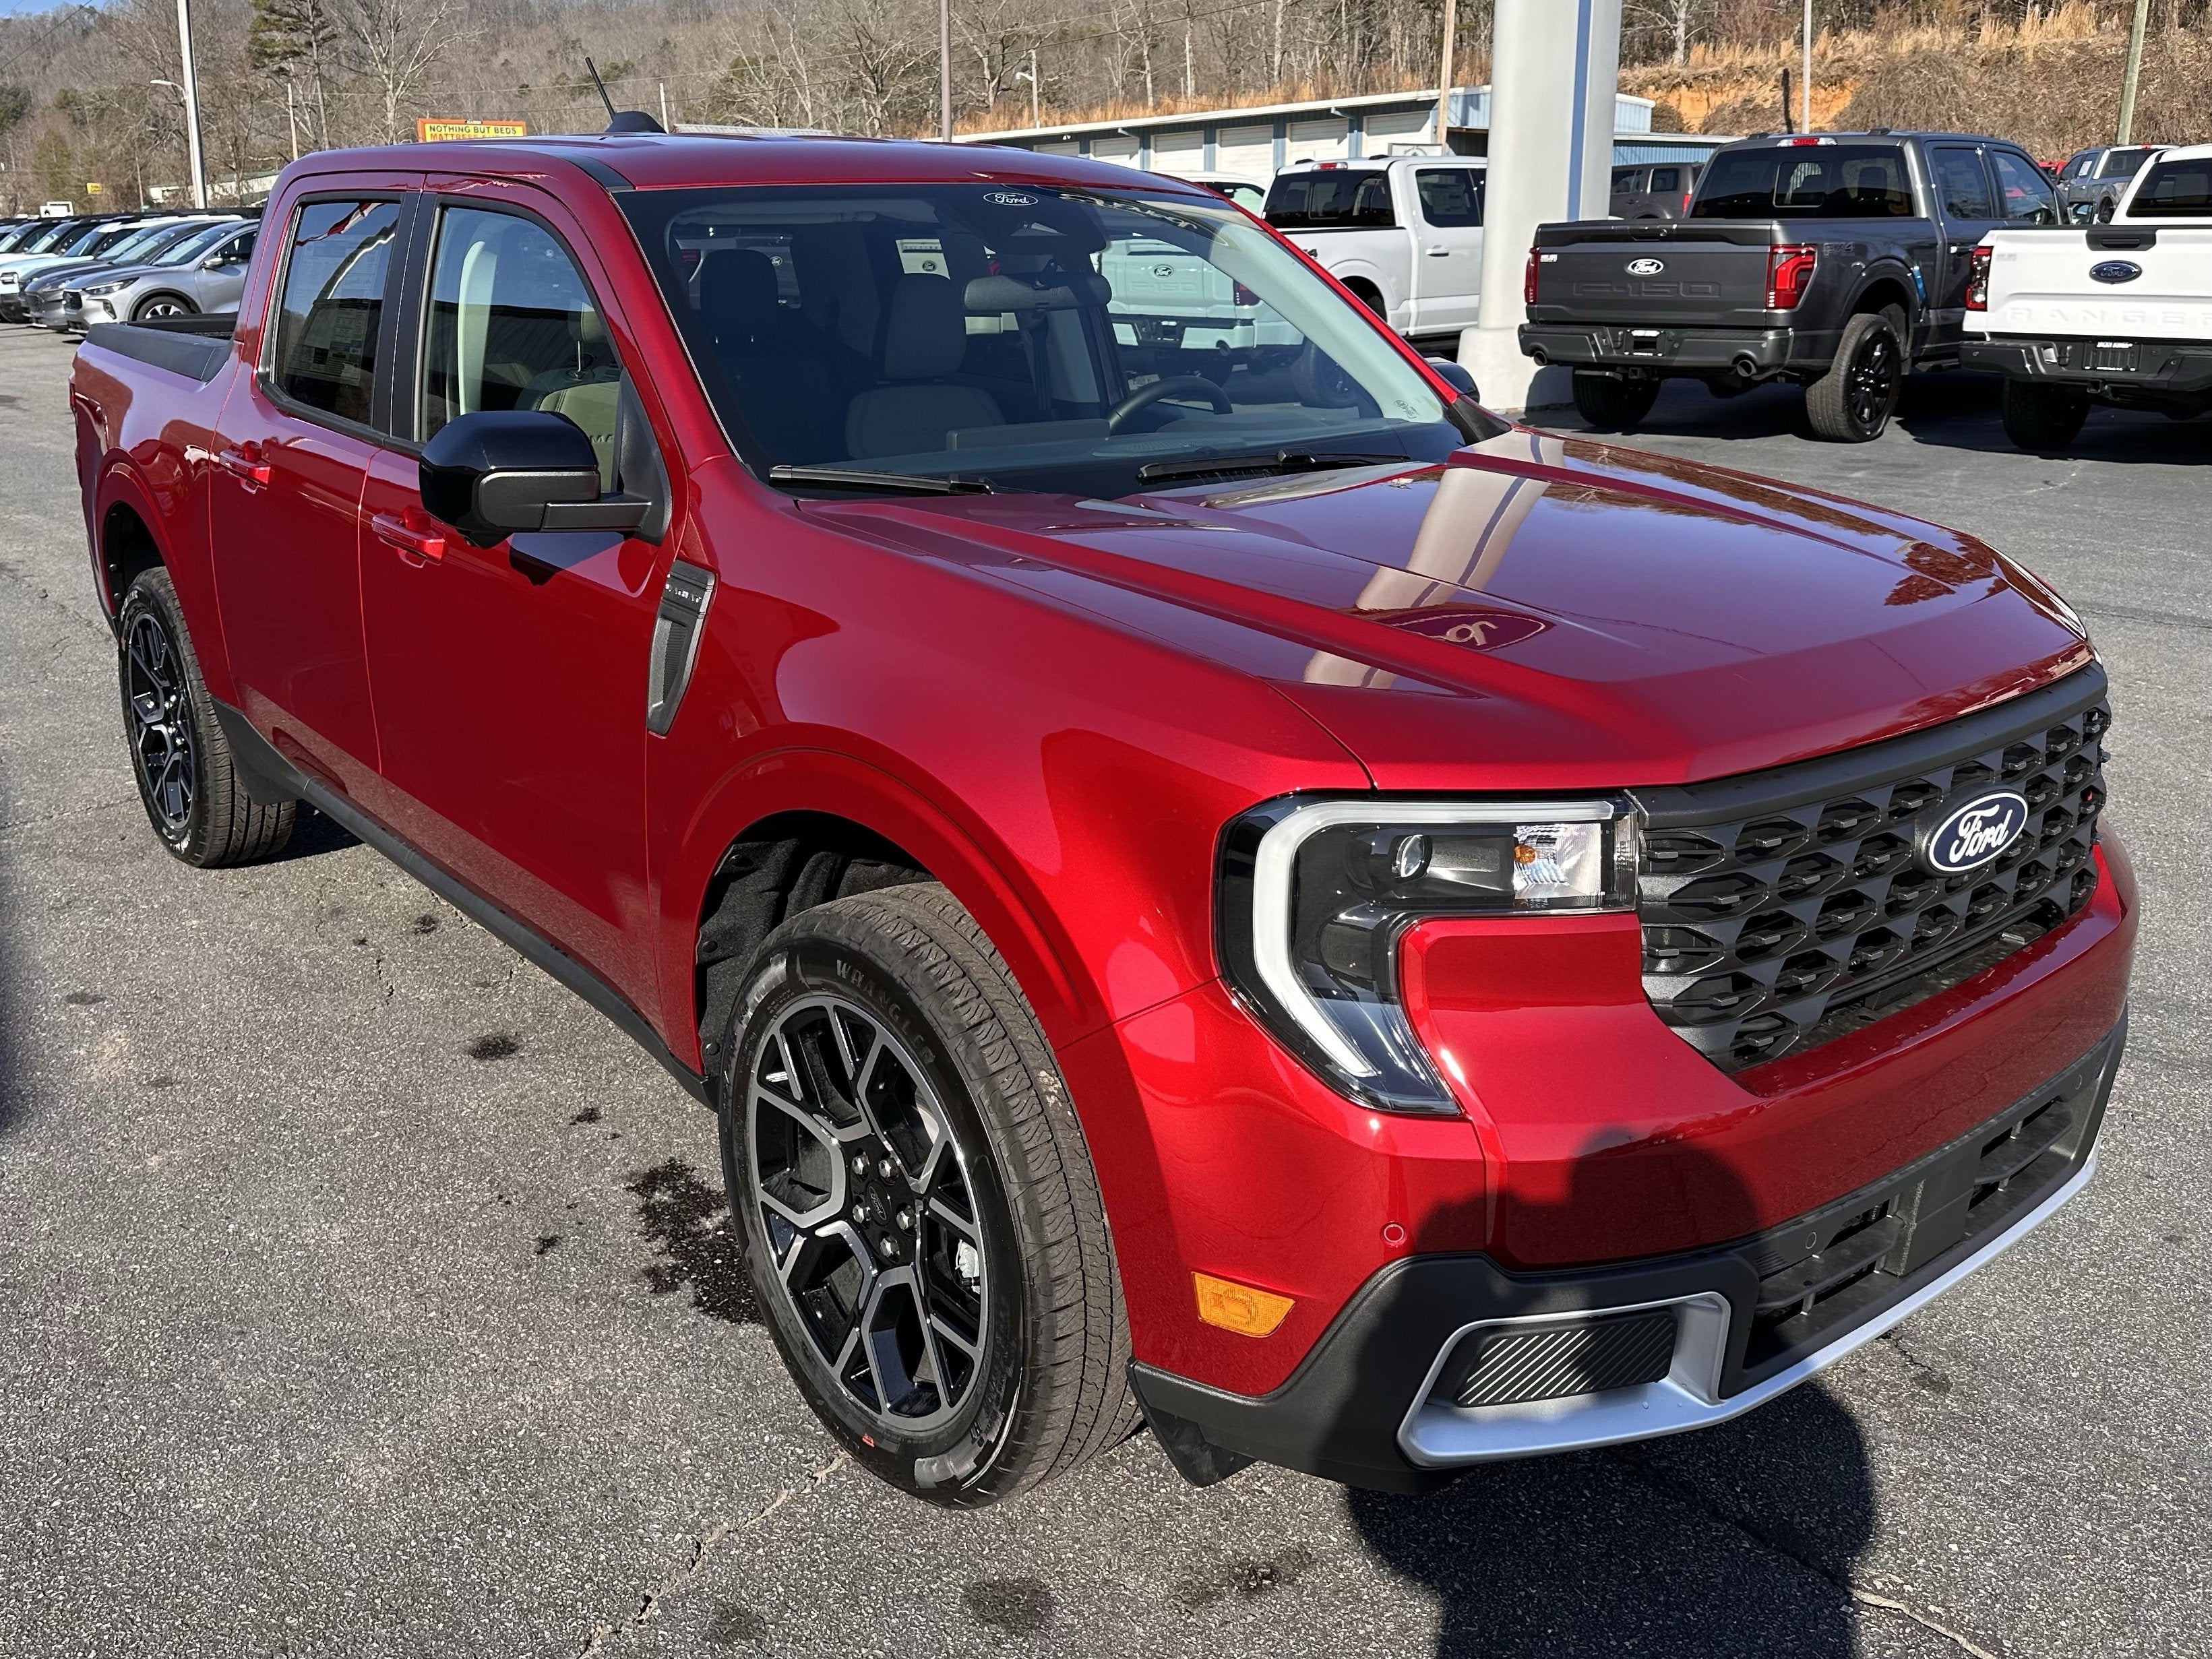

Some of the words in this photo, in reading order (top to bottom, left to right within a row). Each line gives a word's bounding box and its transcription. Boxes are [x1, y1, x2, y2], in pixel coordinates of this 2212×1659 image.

[473, 126, 491, 134] BUT
[995, 193, 1029, 204] Ford
[1633, 261, 1658, 273] Ford
[2100, 265, 2127, 277] Ford
[1572, 281, 1722, 298] F-150
[1949, 804, 2013, 863] Ford
[836, 959, 936, 1064] WRANGLER
